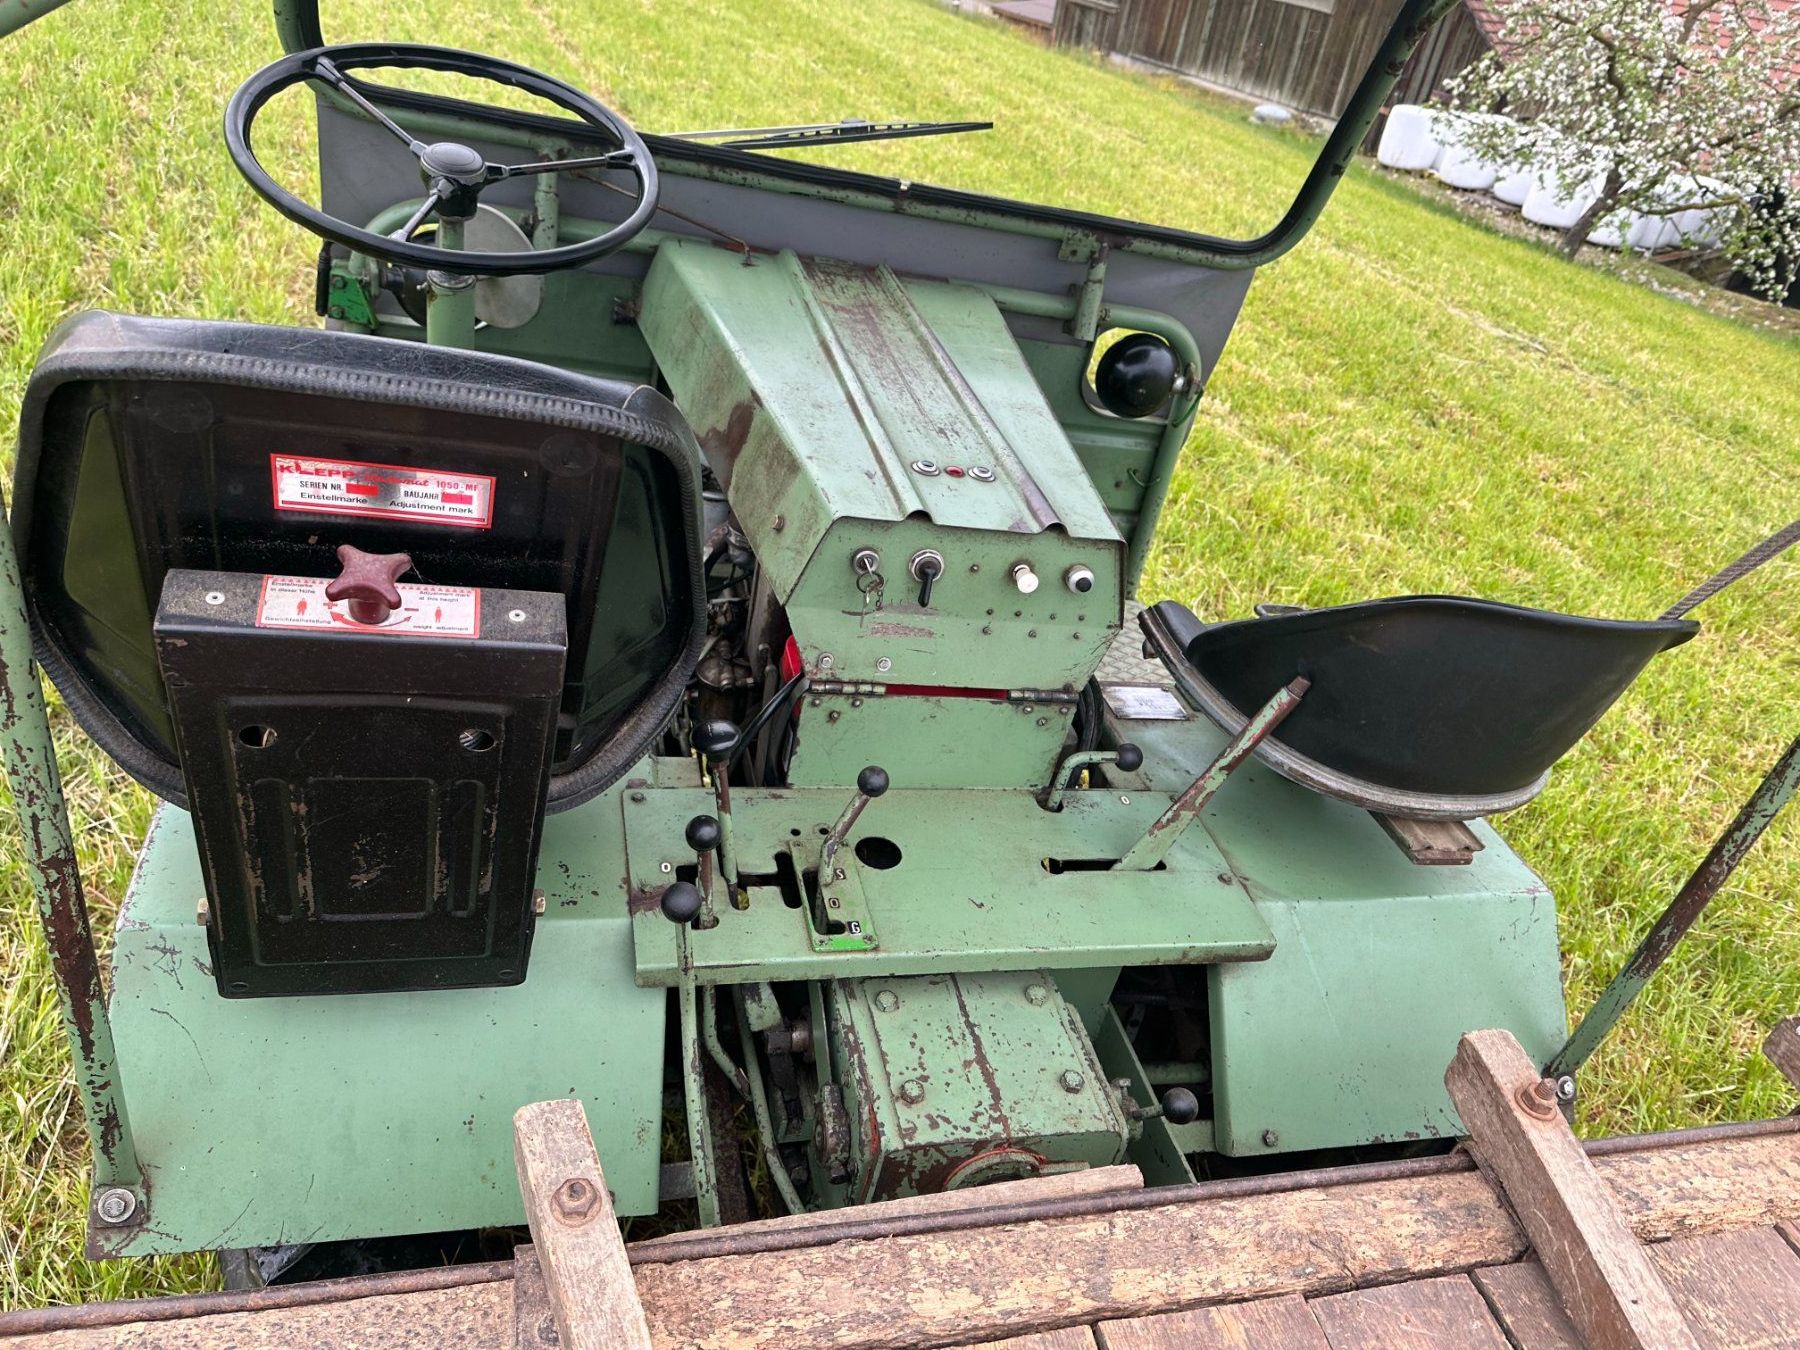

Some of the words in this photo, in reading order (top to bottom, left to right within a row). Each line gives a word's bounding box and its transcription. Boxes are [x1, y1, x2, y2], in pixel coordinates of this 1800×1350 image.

[299, 480, 328, 490] SERIEN
[330, 483, 344, 491] NR.
[300, 492, 368, 504] Einstellmarke
[403, 490, 439, 500] BAUJAHR
[389, 500, 446, 512] Adjustment
[835, 868, 845, 880] S
[850, 921, 862, 934] G
